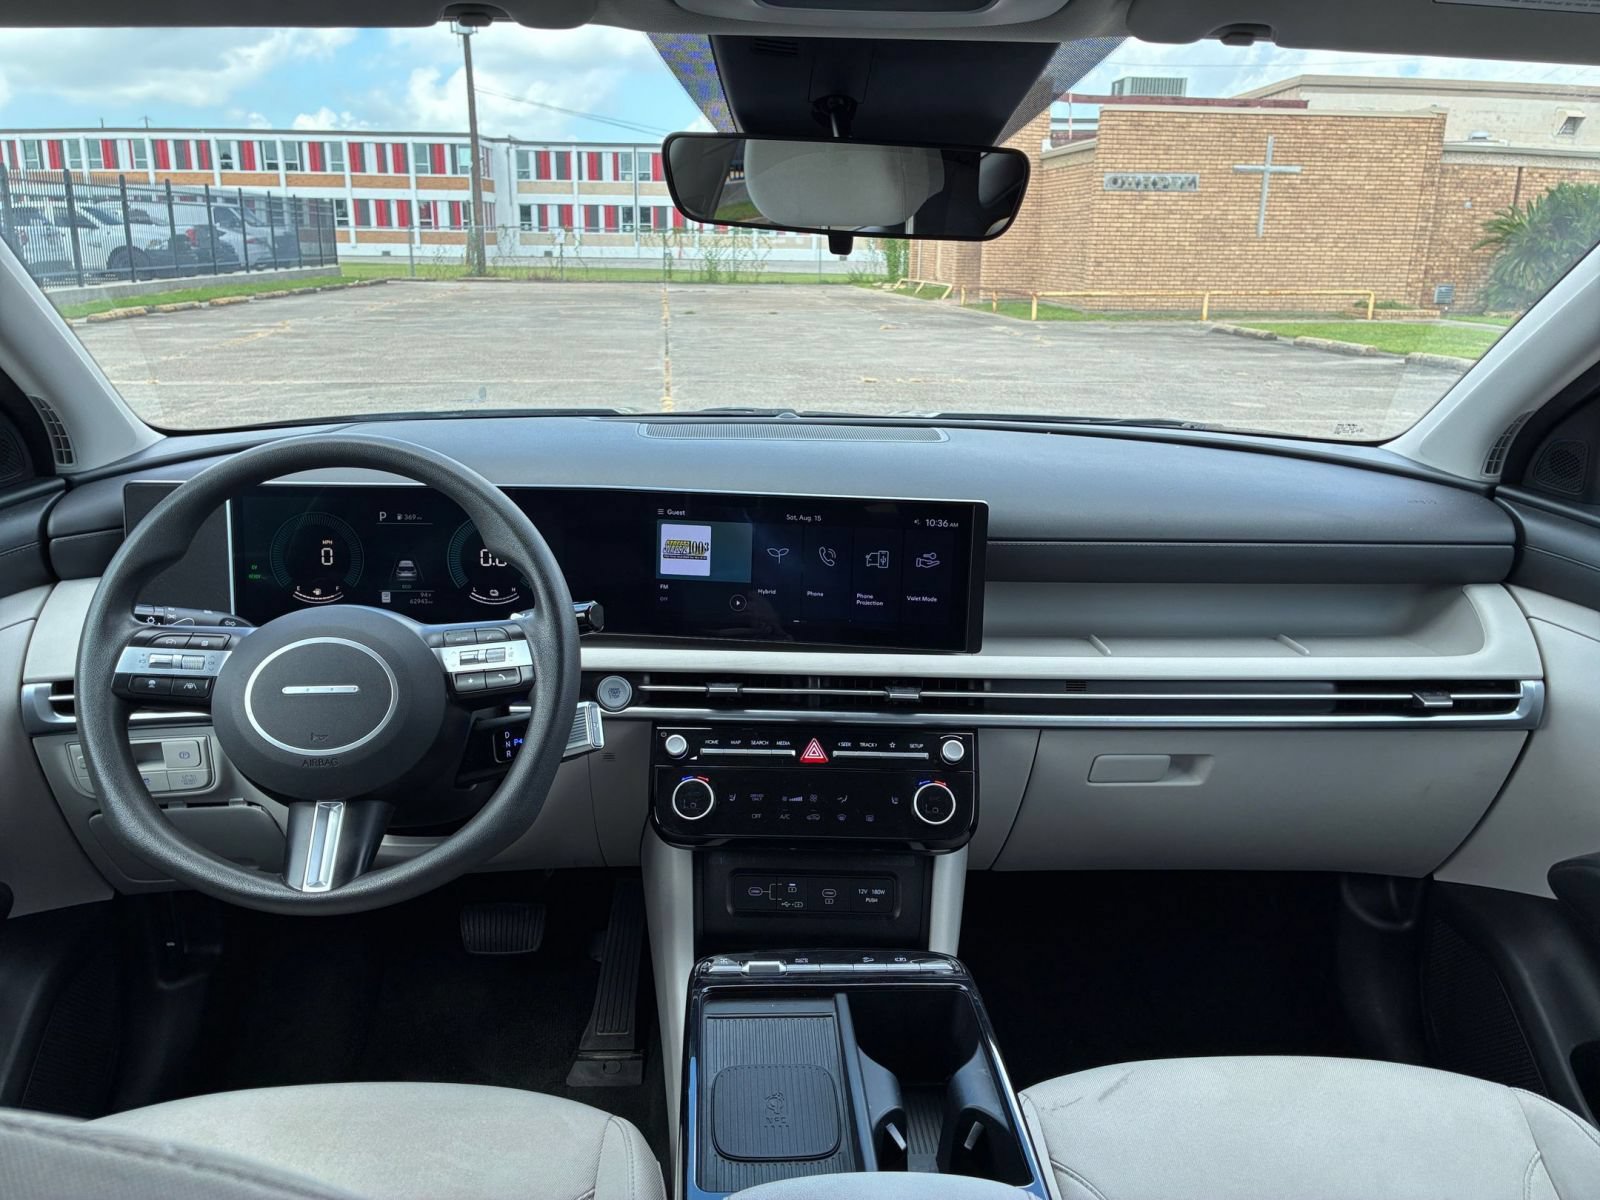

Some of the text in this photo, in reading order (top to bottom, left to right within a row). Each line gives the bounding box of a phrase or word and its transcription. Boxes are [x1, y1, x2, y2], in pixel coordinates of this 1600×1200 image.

[379, 511, 387, 521] P
[321, 547, 333, 565] 0
[506, 750, 512, 758] R
[302, 758, 339, 768] AIRBAG
